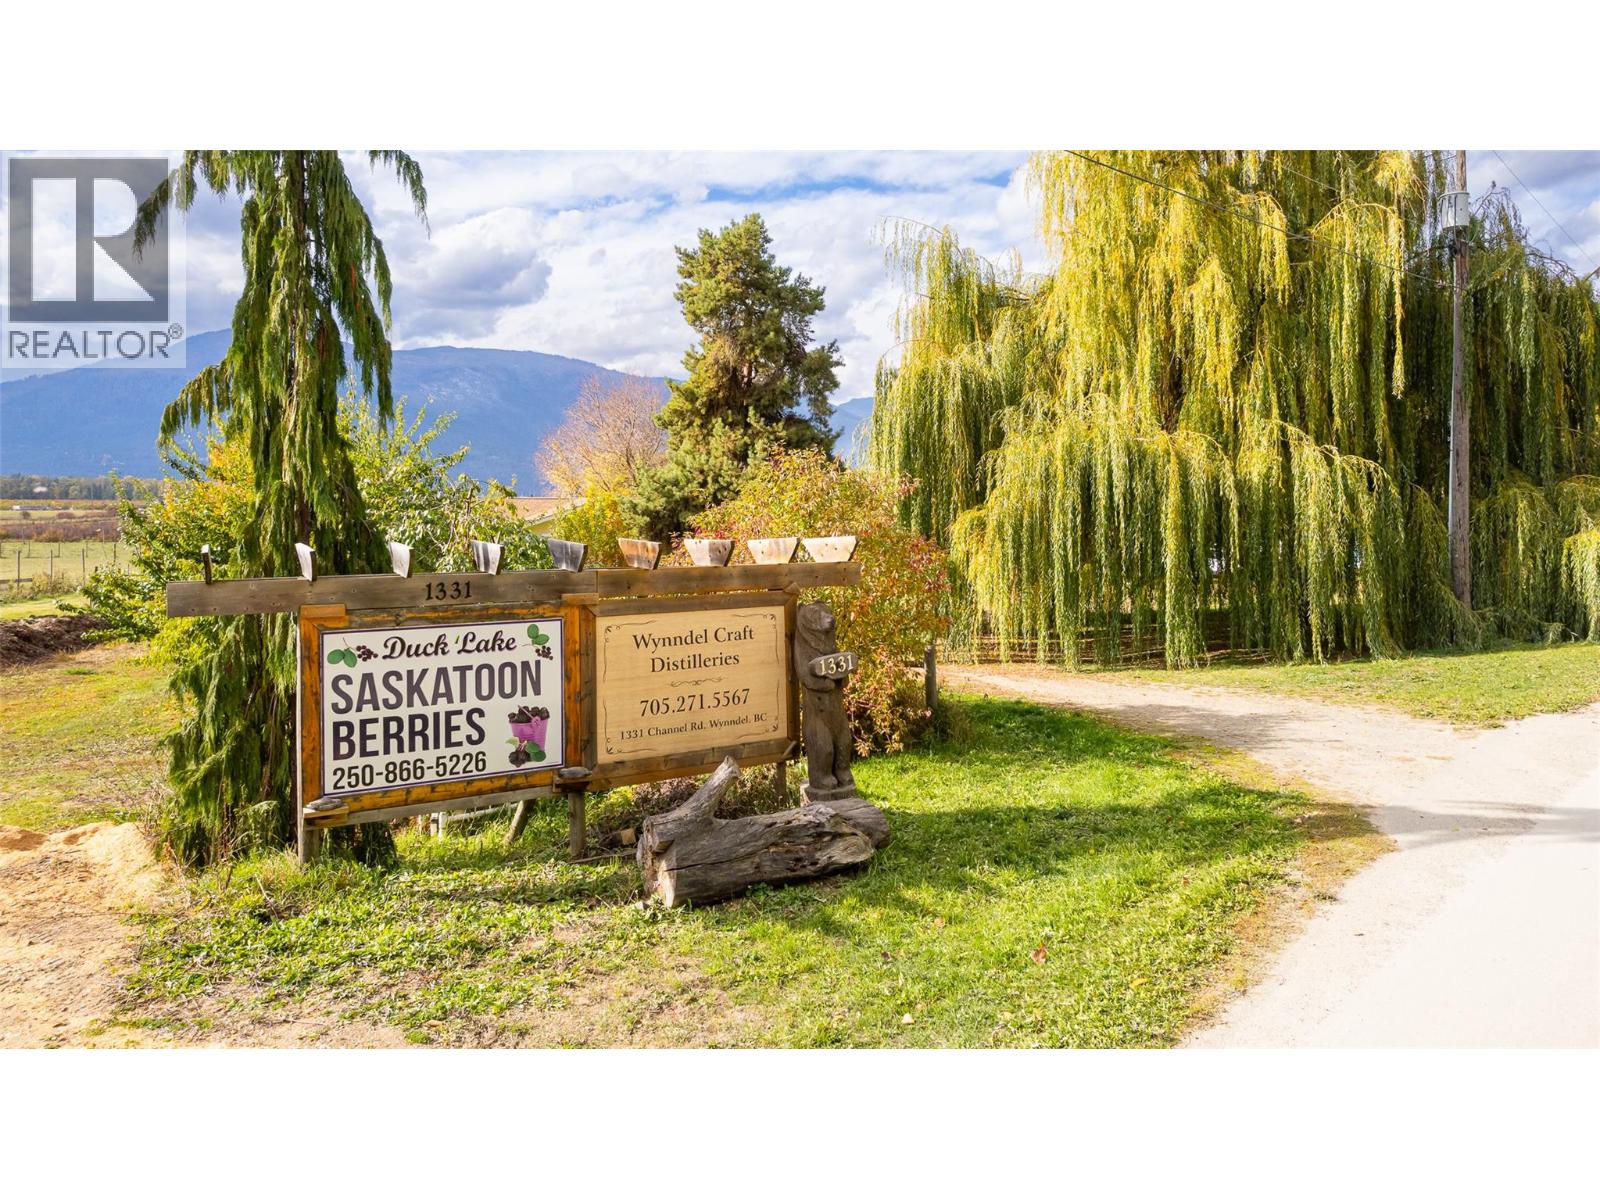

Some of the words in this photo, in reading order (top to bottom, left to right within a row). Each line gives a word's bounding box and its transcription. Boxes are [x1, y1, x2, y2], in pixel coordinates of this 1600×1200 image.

[425, 581, 473, 600] 1331
[382, 633, 449, 660] Duck
[455, 630, 517, 655] Lake
[632, 629, 708, 654] Wynndel
[714, 625, 755, 643] Craft
[650, 652, 740, 673] Distilleries
[820, 654, 855, 675] 1331
[331, 659, 542, 715] SASKATOON
[640, 688, 750, 717] 705.271.5567
[332, 707, 486, 761] BERRIES
[620, 729, 644, 741] 1331
[647, 726, 687, 737] Channel
[753, 712, 768, 722] BC
[332, 751, 487, 790] 250-866-5226
